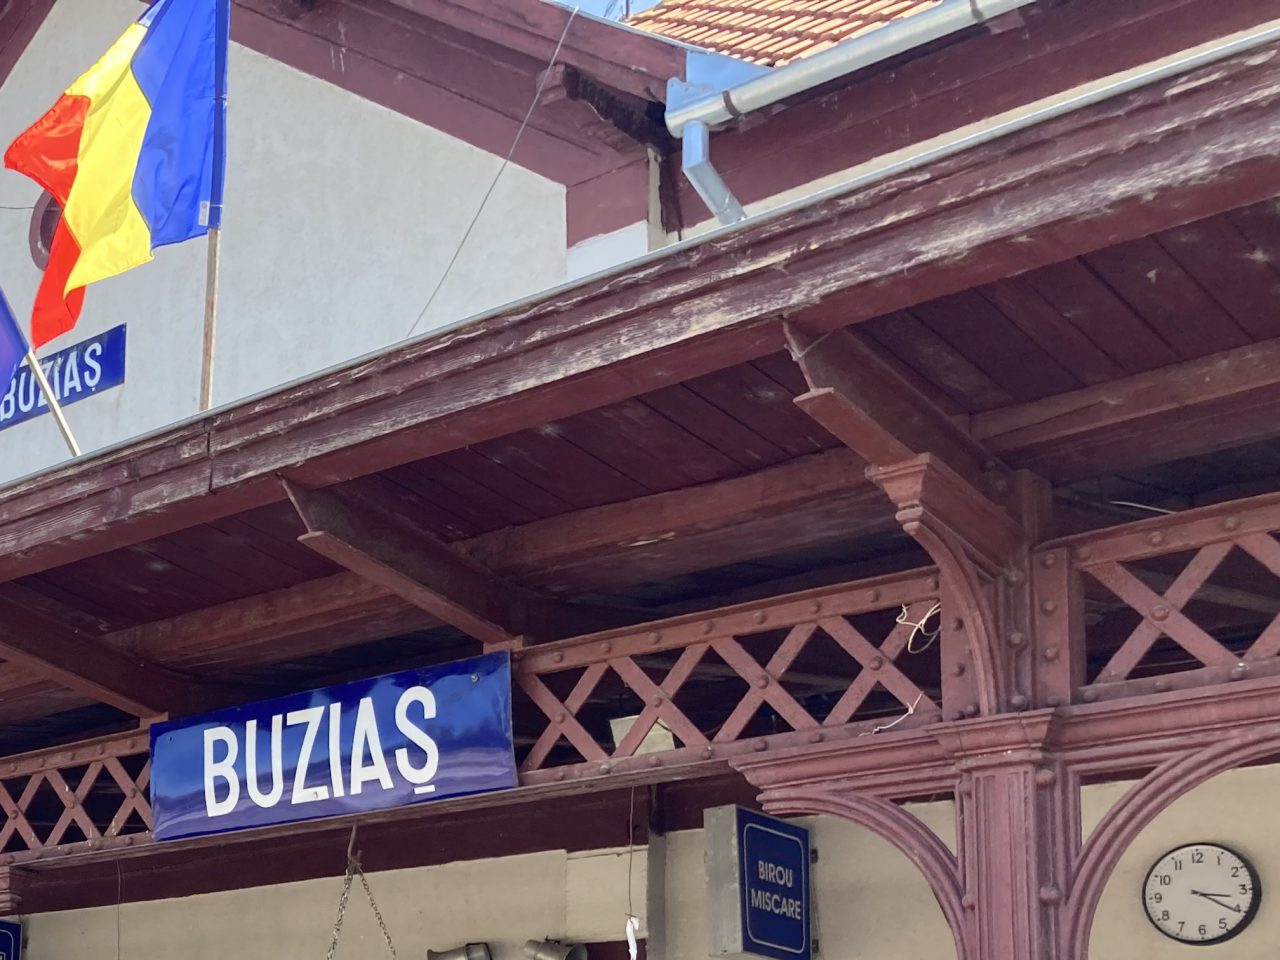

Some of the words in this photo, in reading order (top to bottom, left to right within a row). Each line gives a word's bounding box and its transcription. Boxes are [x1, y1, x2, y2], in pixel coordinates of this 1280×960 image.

[203, 686, 439, 817] BUZIAȘ
[1191, 853, 1204, 864] 12
[1174, 860, 1183, 871] 11
[757, 860, 793, 888] BIROU
[1231, 866, 1239, 878] 2
[1159, 875, 1172, 886] 10
[1238, 884, 1248, 895] 3
[1154, 892, 1162, 903] 9
[1161, 910, 1170, 921] 8
[1177, 921, 1186, 932] 7
[1218, 918, 1227, 929] 5
[1198, 924, 1207, 935] 6
